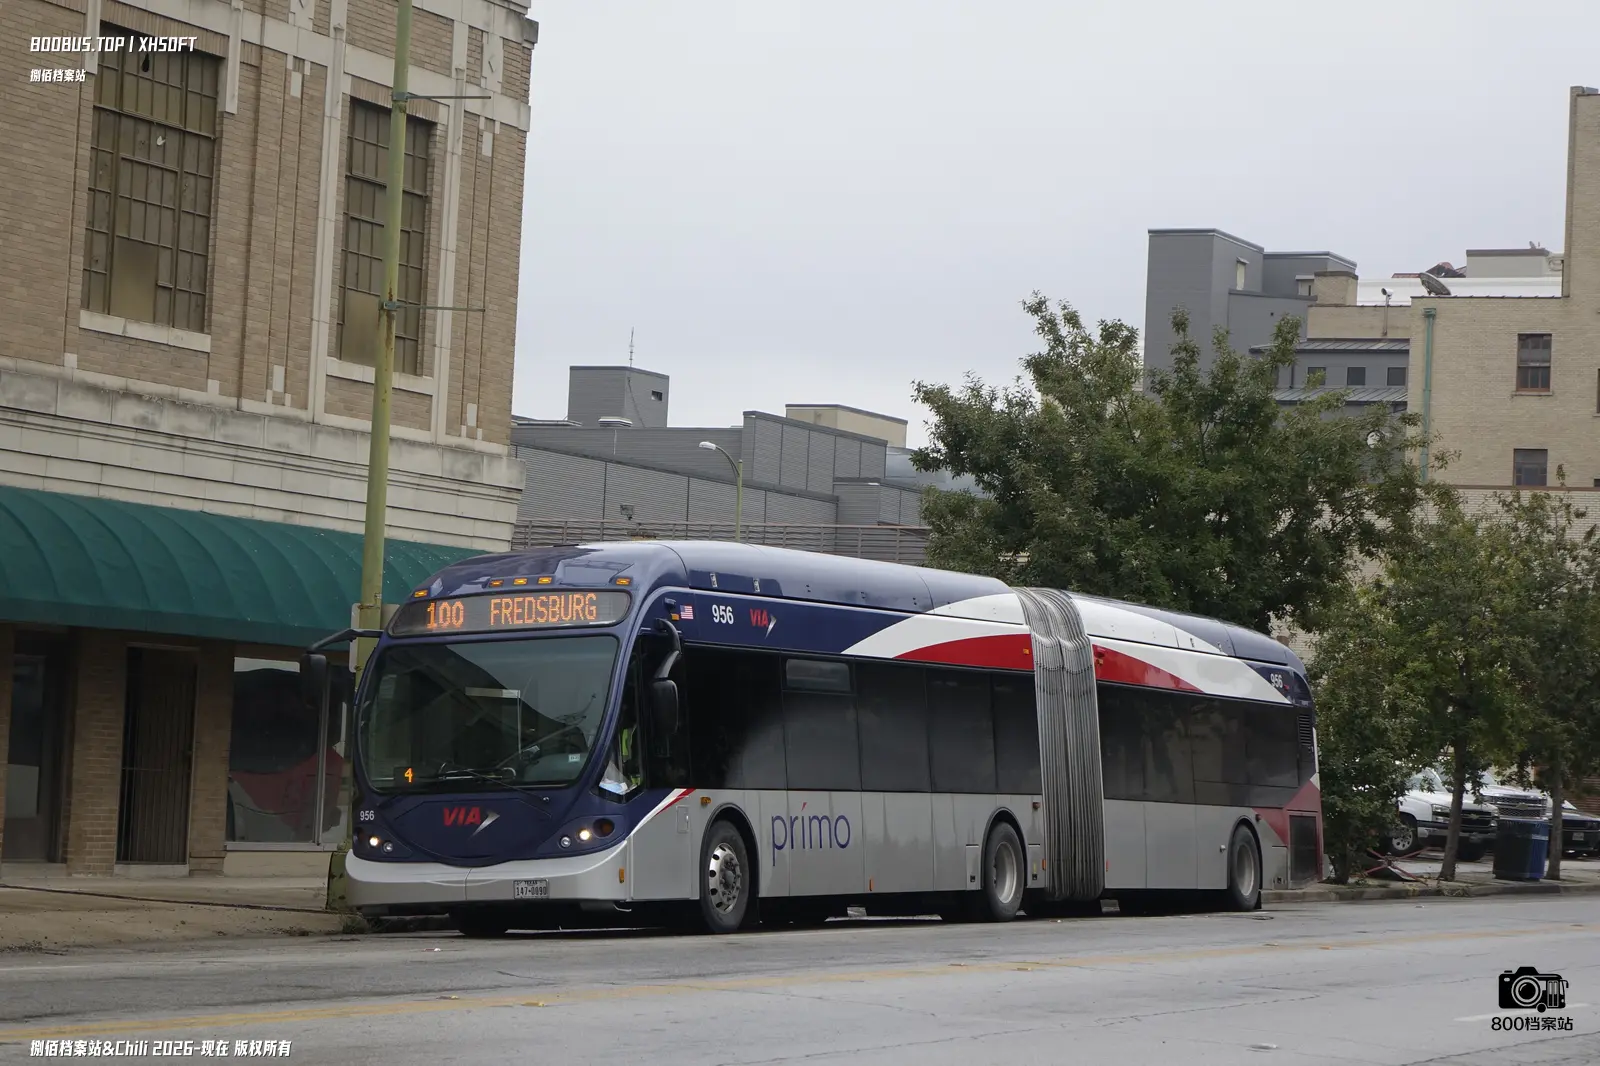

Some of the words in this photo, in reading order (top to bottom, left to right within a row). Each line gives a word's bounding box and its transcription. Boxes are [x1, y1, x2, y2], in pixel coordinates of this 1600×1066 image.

[426, 601, 465, 629] 100
[490, 593, 597, 626] FREDSBURG
[711, 604, 734, 625] 956
[749, 608, 769, 627] VIA
[1270, 673, 1283, 689] 956
[404, 767, 414, 783] 4
[359, 810, 375, 821] 956
[443, 807, 481, 826] VIA
